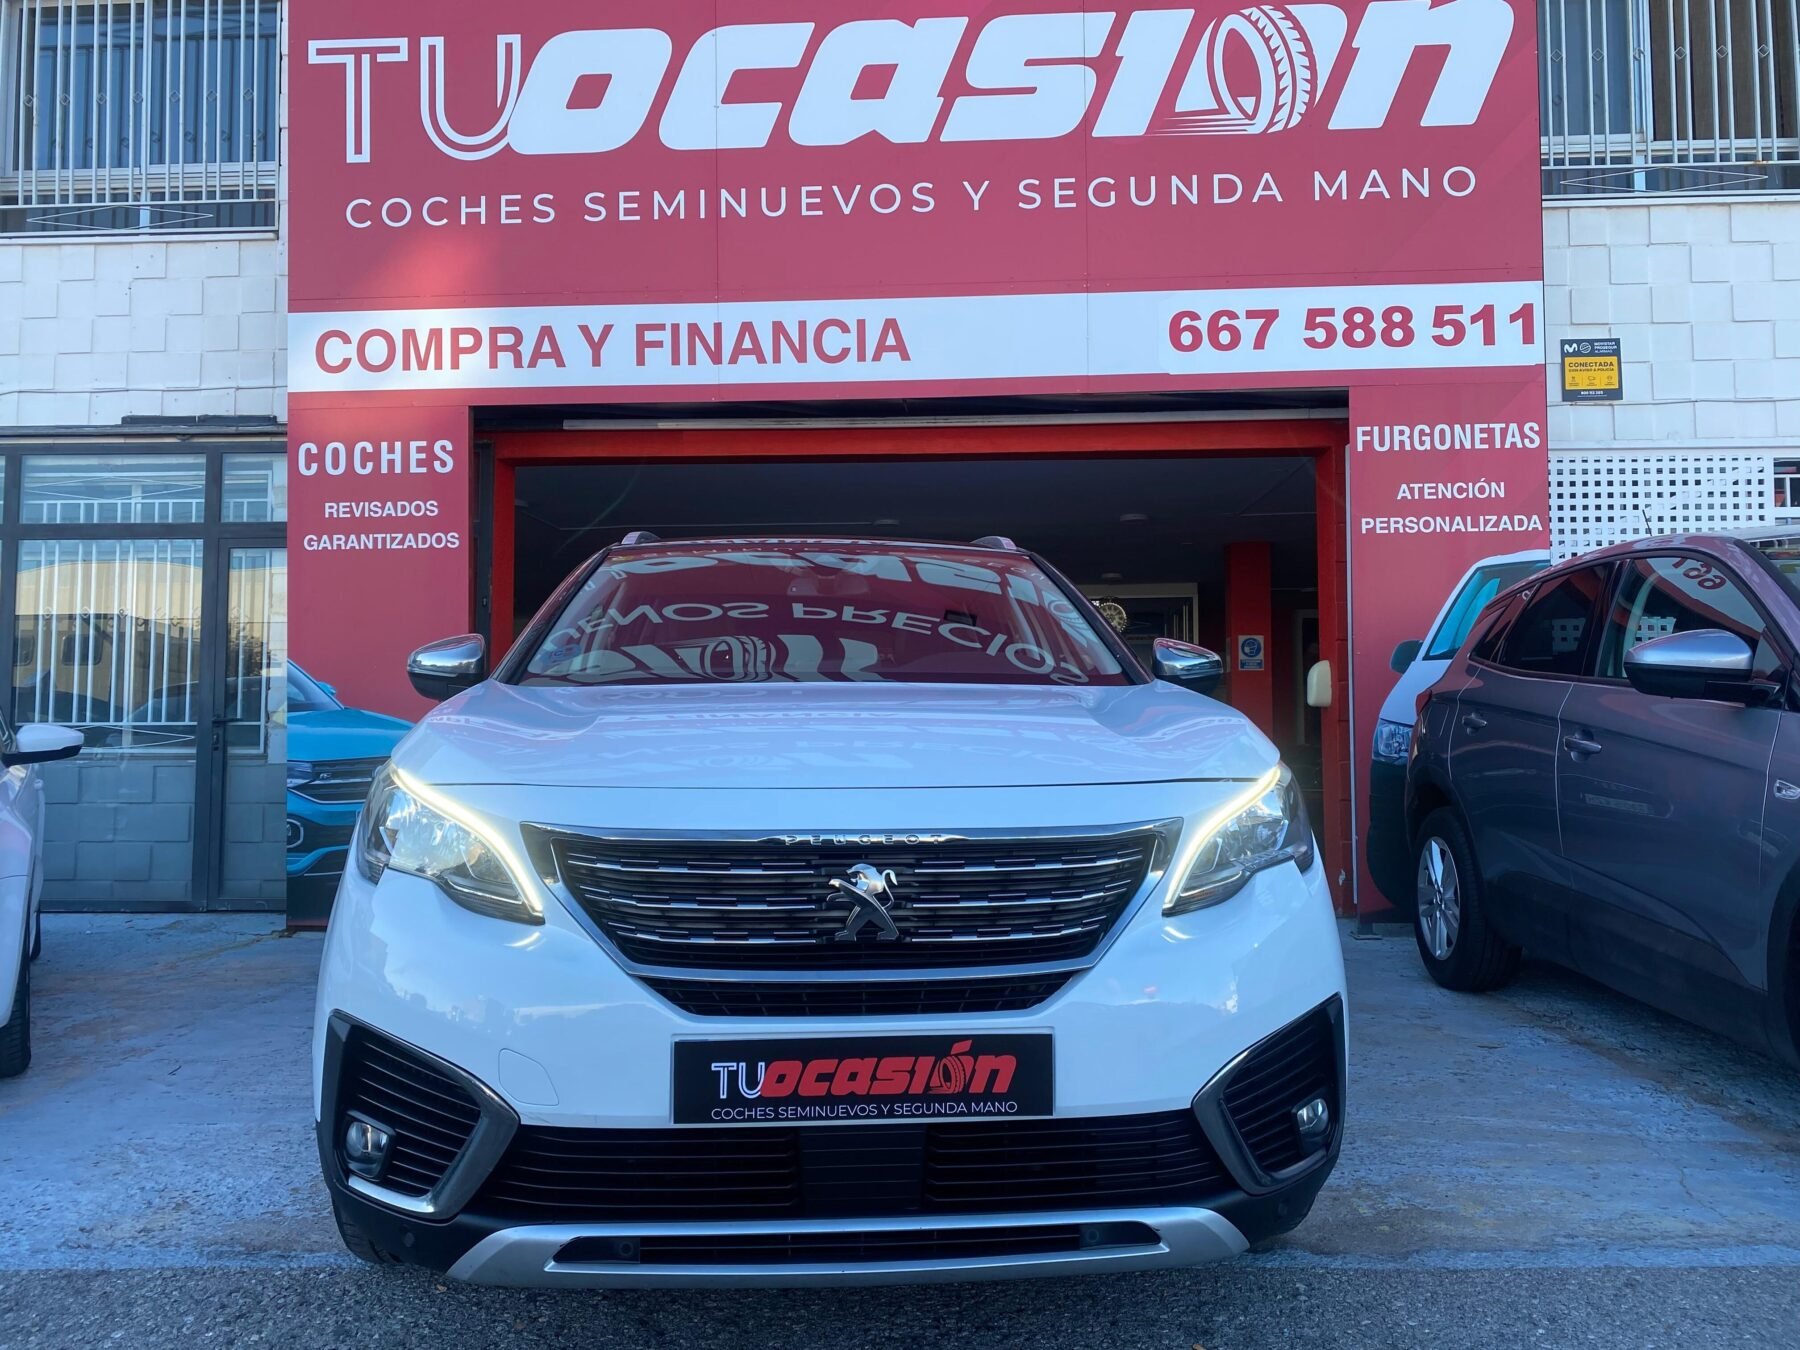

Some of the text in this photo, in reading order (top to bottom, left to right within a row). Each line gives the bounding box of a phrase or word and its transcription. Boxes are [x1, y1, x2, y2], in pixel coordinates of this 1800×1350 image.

[345, 165, 1477, 229] COCHES SEMINUEVOS Y SEGUNDA MANO
[1168, 302, 1535, 353] 667 588 511
[315, 317, 912, 375] COMPRA Y FINANCIA
[1355, 421, 1541, 452] FURGONETAS
[297, 439, 454, 476] COCHES
[1396, 477, 1506, 500] ATENCIÓN
[324, 500, 439, 518] REVISADOS
[1360, 514, 1543, 534] PERSONALIZADA
[303, 532, 460, 551] GARANTIZADOS
[784, 834, 942, 846] PEUGEOT
[711, 1100, 1018, 1120] COCHES SEMINUEVOS Y SEGUNDA MANO
